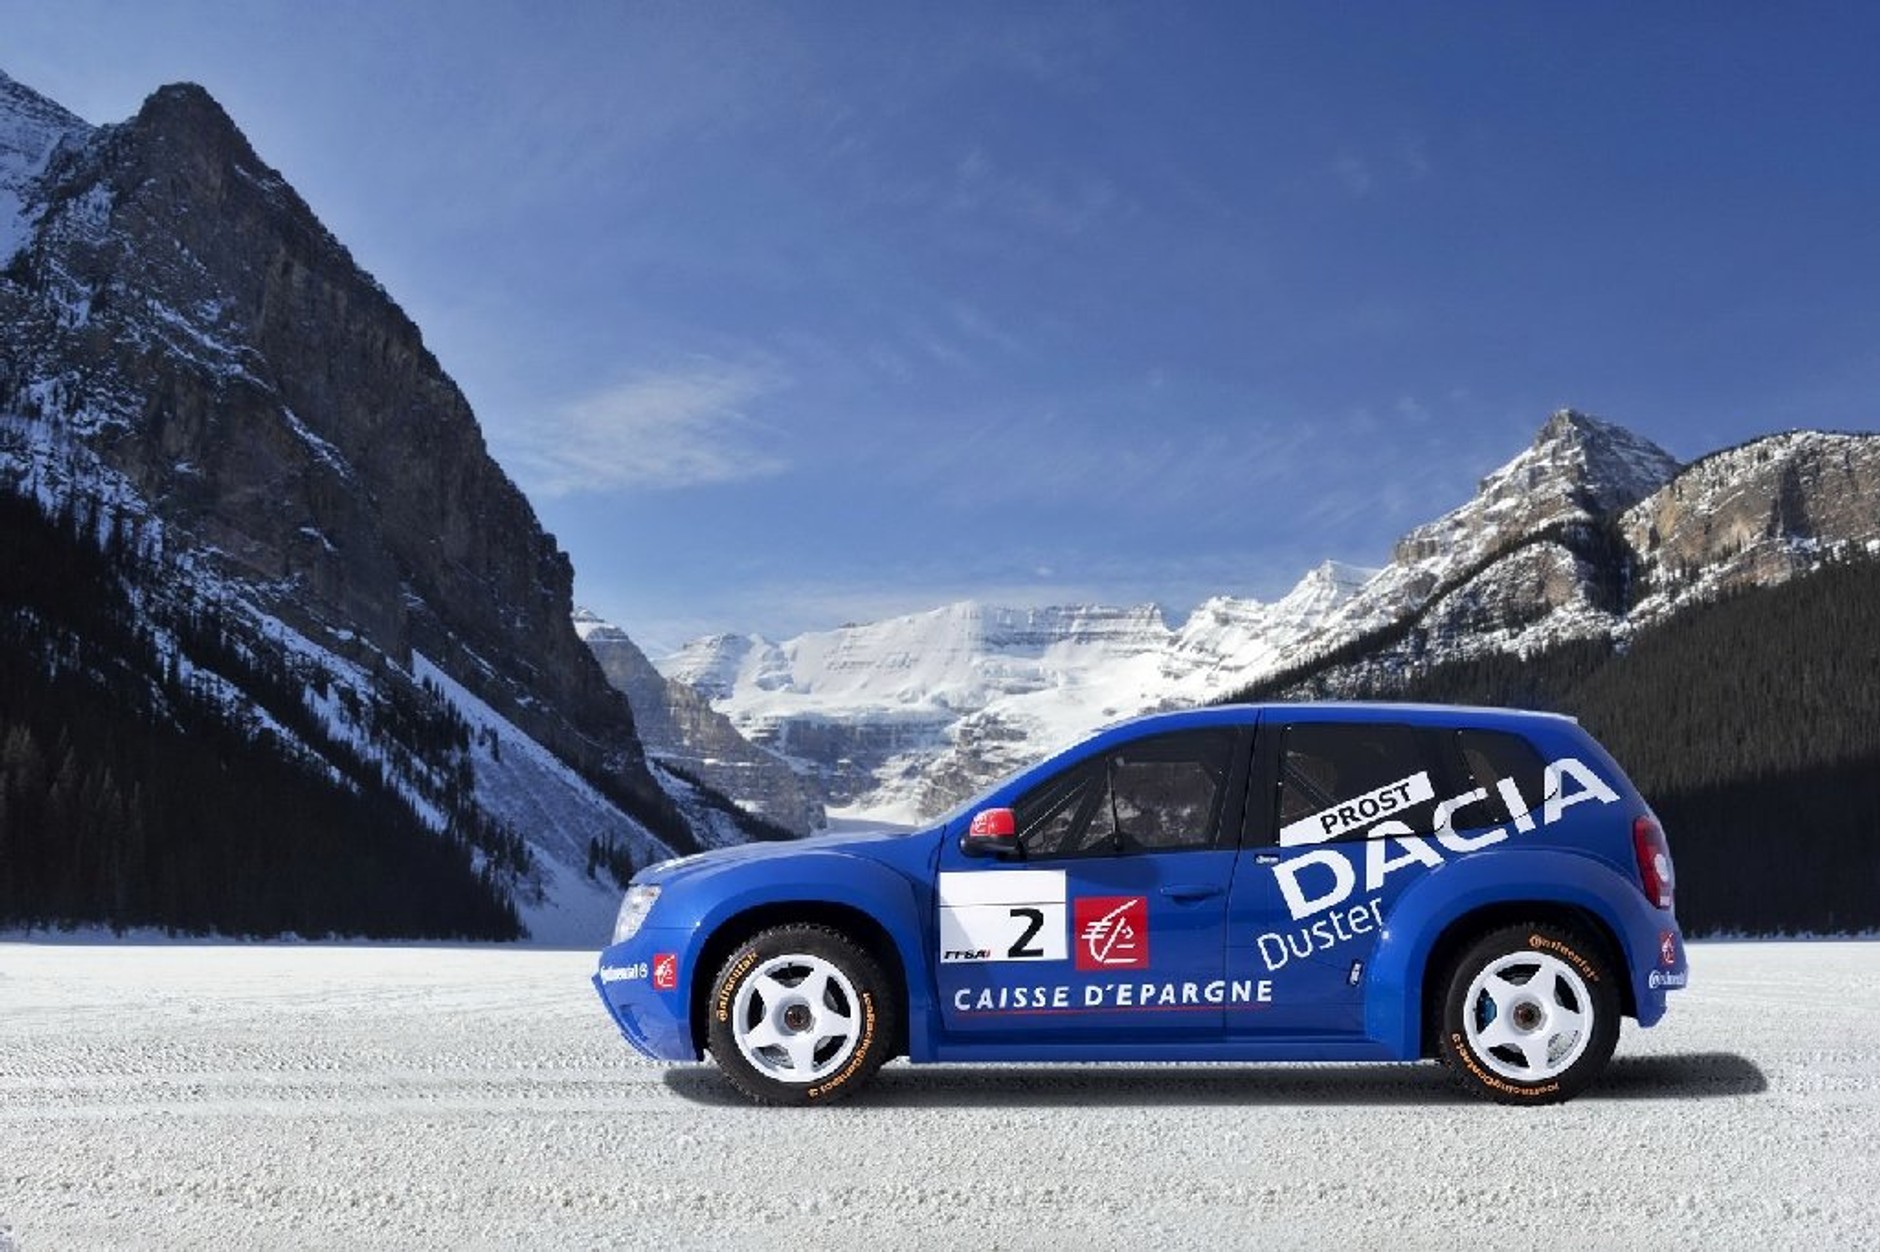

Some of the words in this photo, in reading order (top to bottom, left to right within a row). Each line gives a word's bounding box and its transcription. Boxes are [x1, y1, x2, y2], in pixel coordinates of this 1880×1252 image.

[1320, 782, 1412, 835] PROST
[1272, 757, 1621, 922] DACIA
[1007, 908, 1044, 958] 2
[1256, 897, 1383, 972] Duster
[954, 986, 1070, 1010] CAISSE
[1085, 979, 1273, 1007] D'EPARGNE
